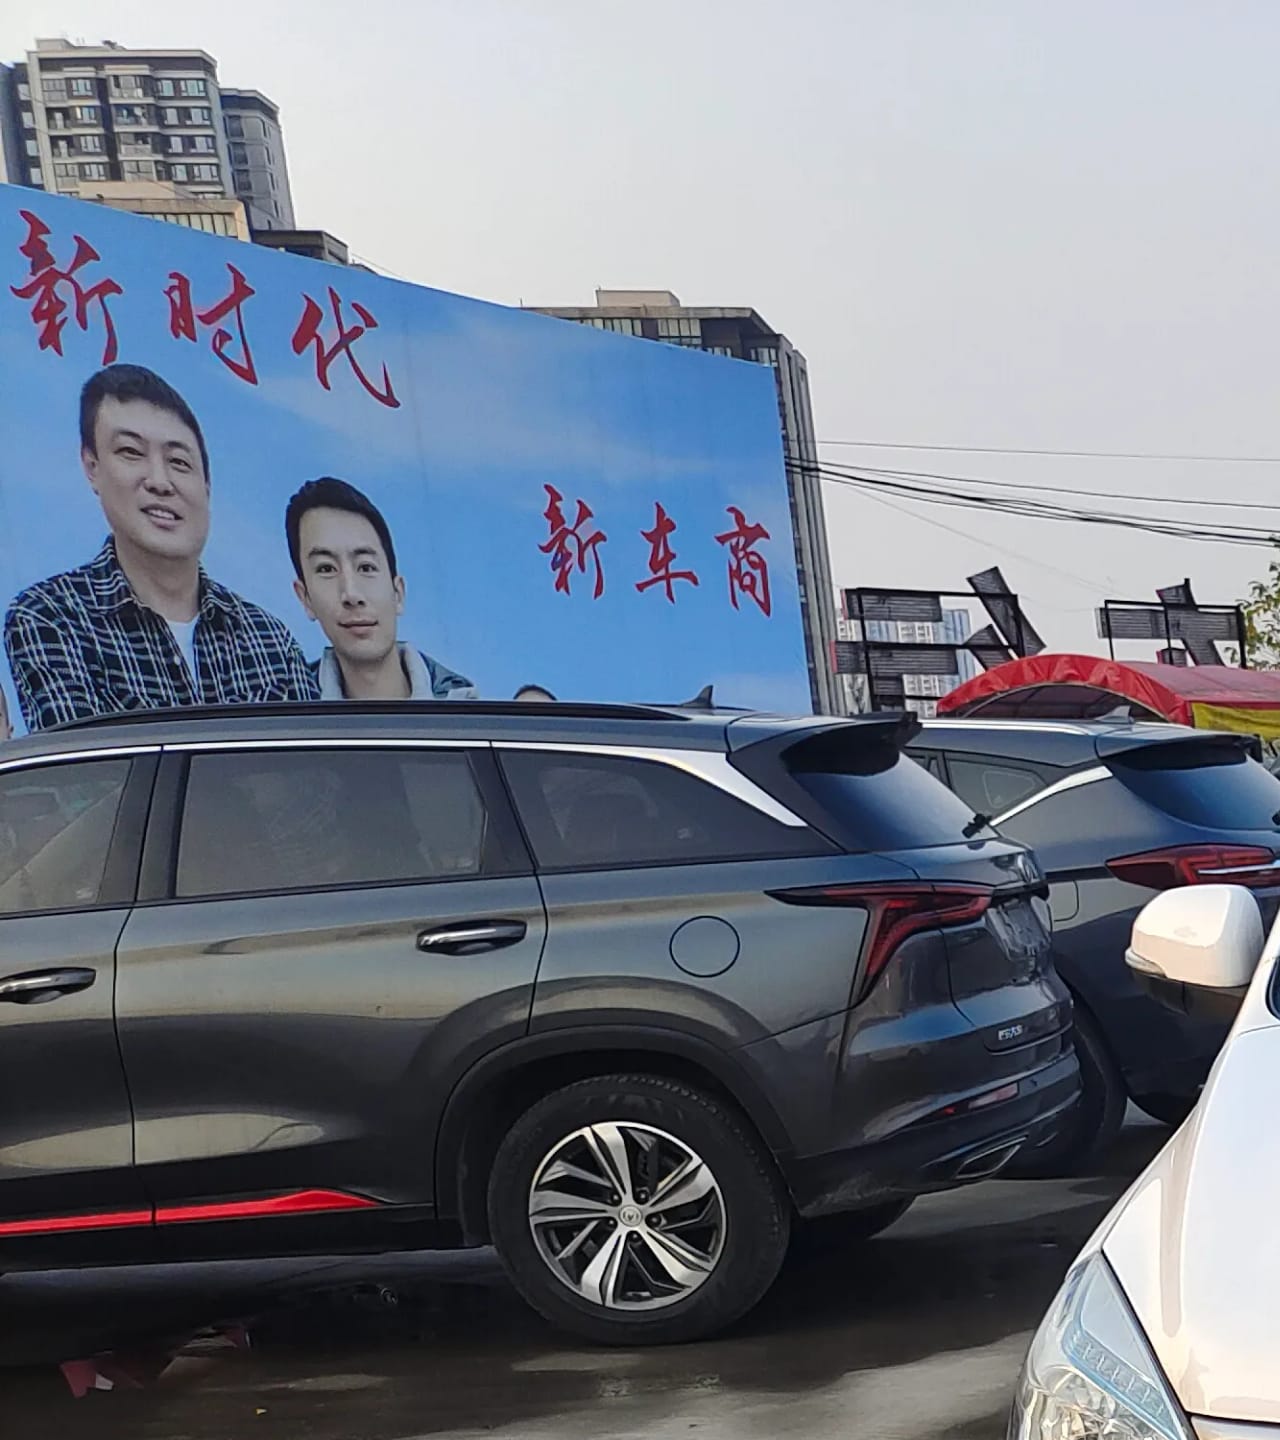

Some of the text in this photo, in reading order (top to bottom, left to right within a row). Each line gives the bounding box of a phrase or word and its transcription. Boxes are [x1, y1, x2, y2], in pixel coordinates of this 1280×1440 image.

[9, 208, 401, 409] 新时代
[537, 483, 771, 617] 新车商
